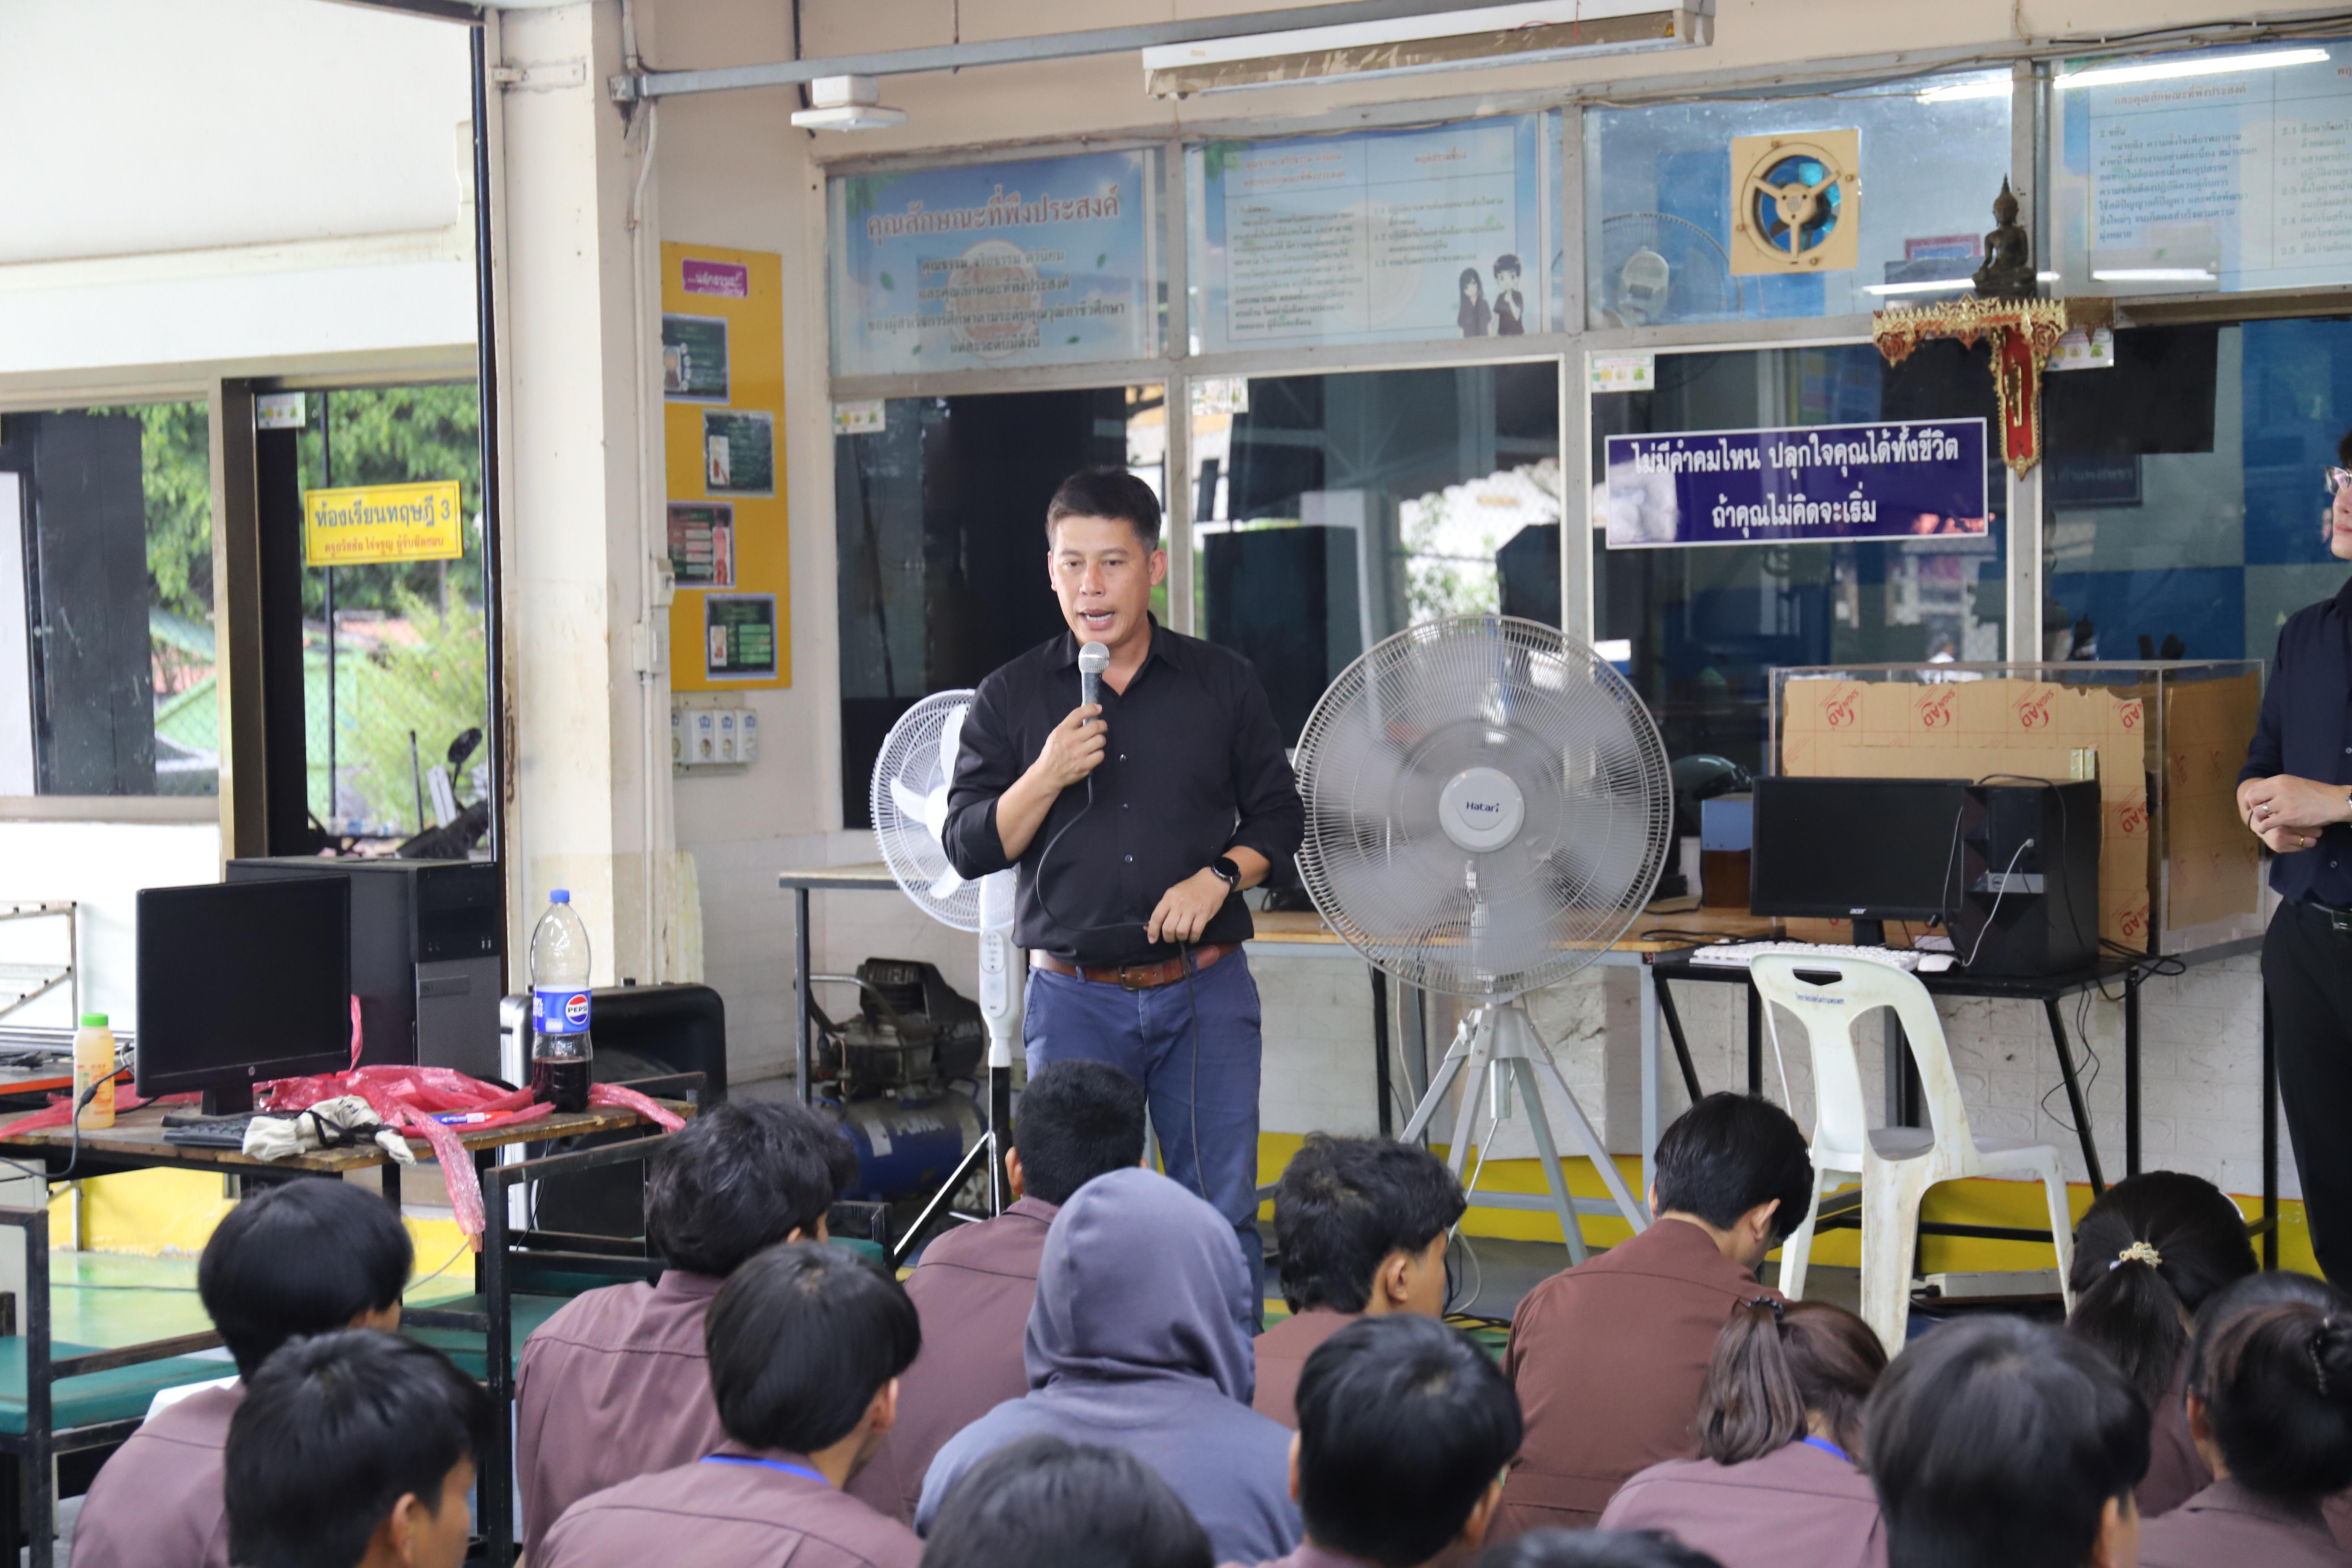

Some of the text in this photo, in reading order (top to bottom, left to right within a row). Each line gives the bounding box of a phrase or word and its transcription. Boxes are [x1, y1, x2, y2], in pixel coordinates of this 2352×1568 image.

[867, 184, 1119, 248] คุณลักษณะที่พึงประสงค์
[1632, 425, 1959, 479] ไม่มีคำคมไหน ปลุกใจคุณได้ทั้งชีวิต
[315, 495, 450, 527] ห้องเรียนทฤษฎี 3
[1712, 482, 1877, 539] ถ้าคุณไม่คิดจะเริ่ม
[1466, 801, 1499, 813] Hatari
